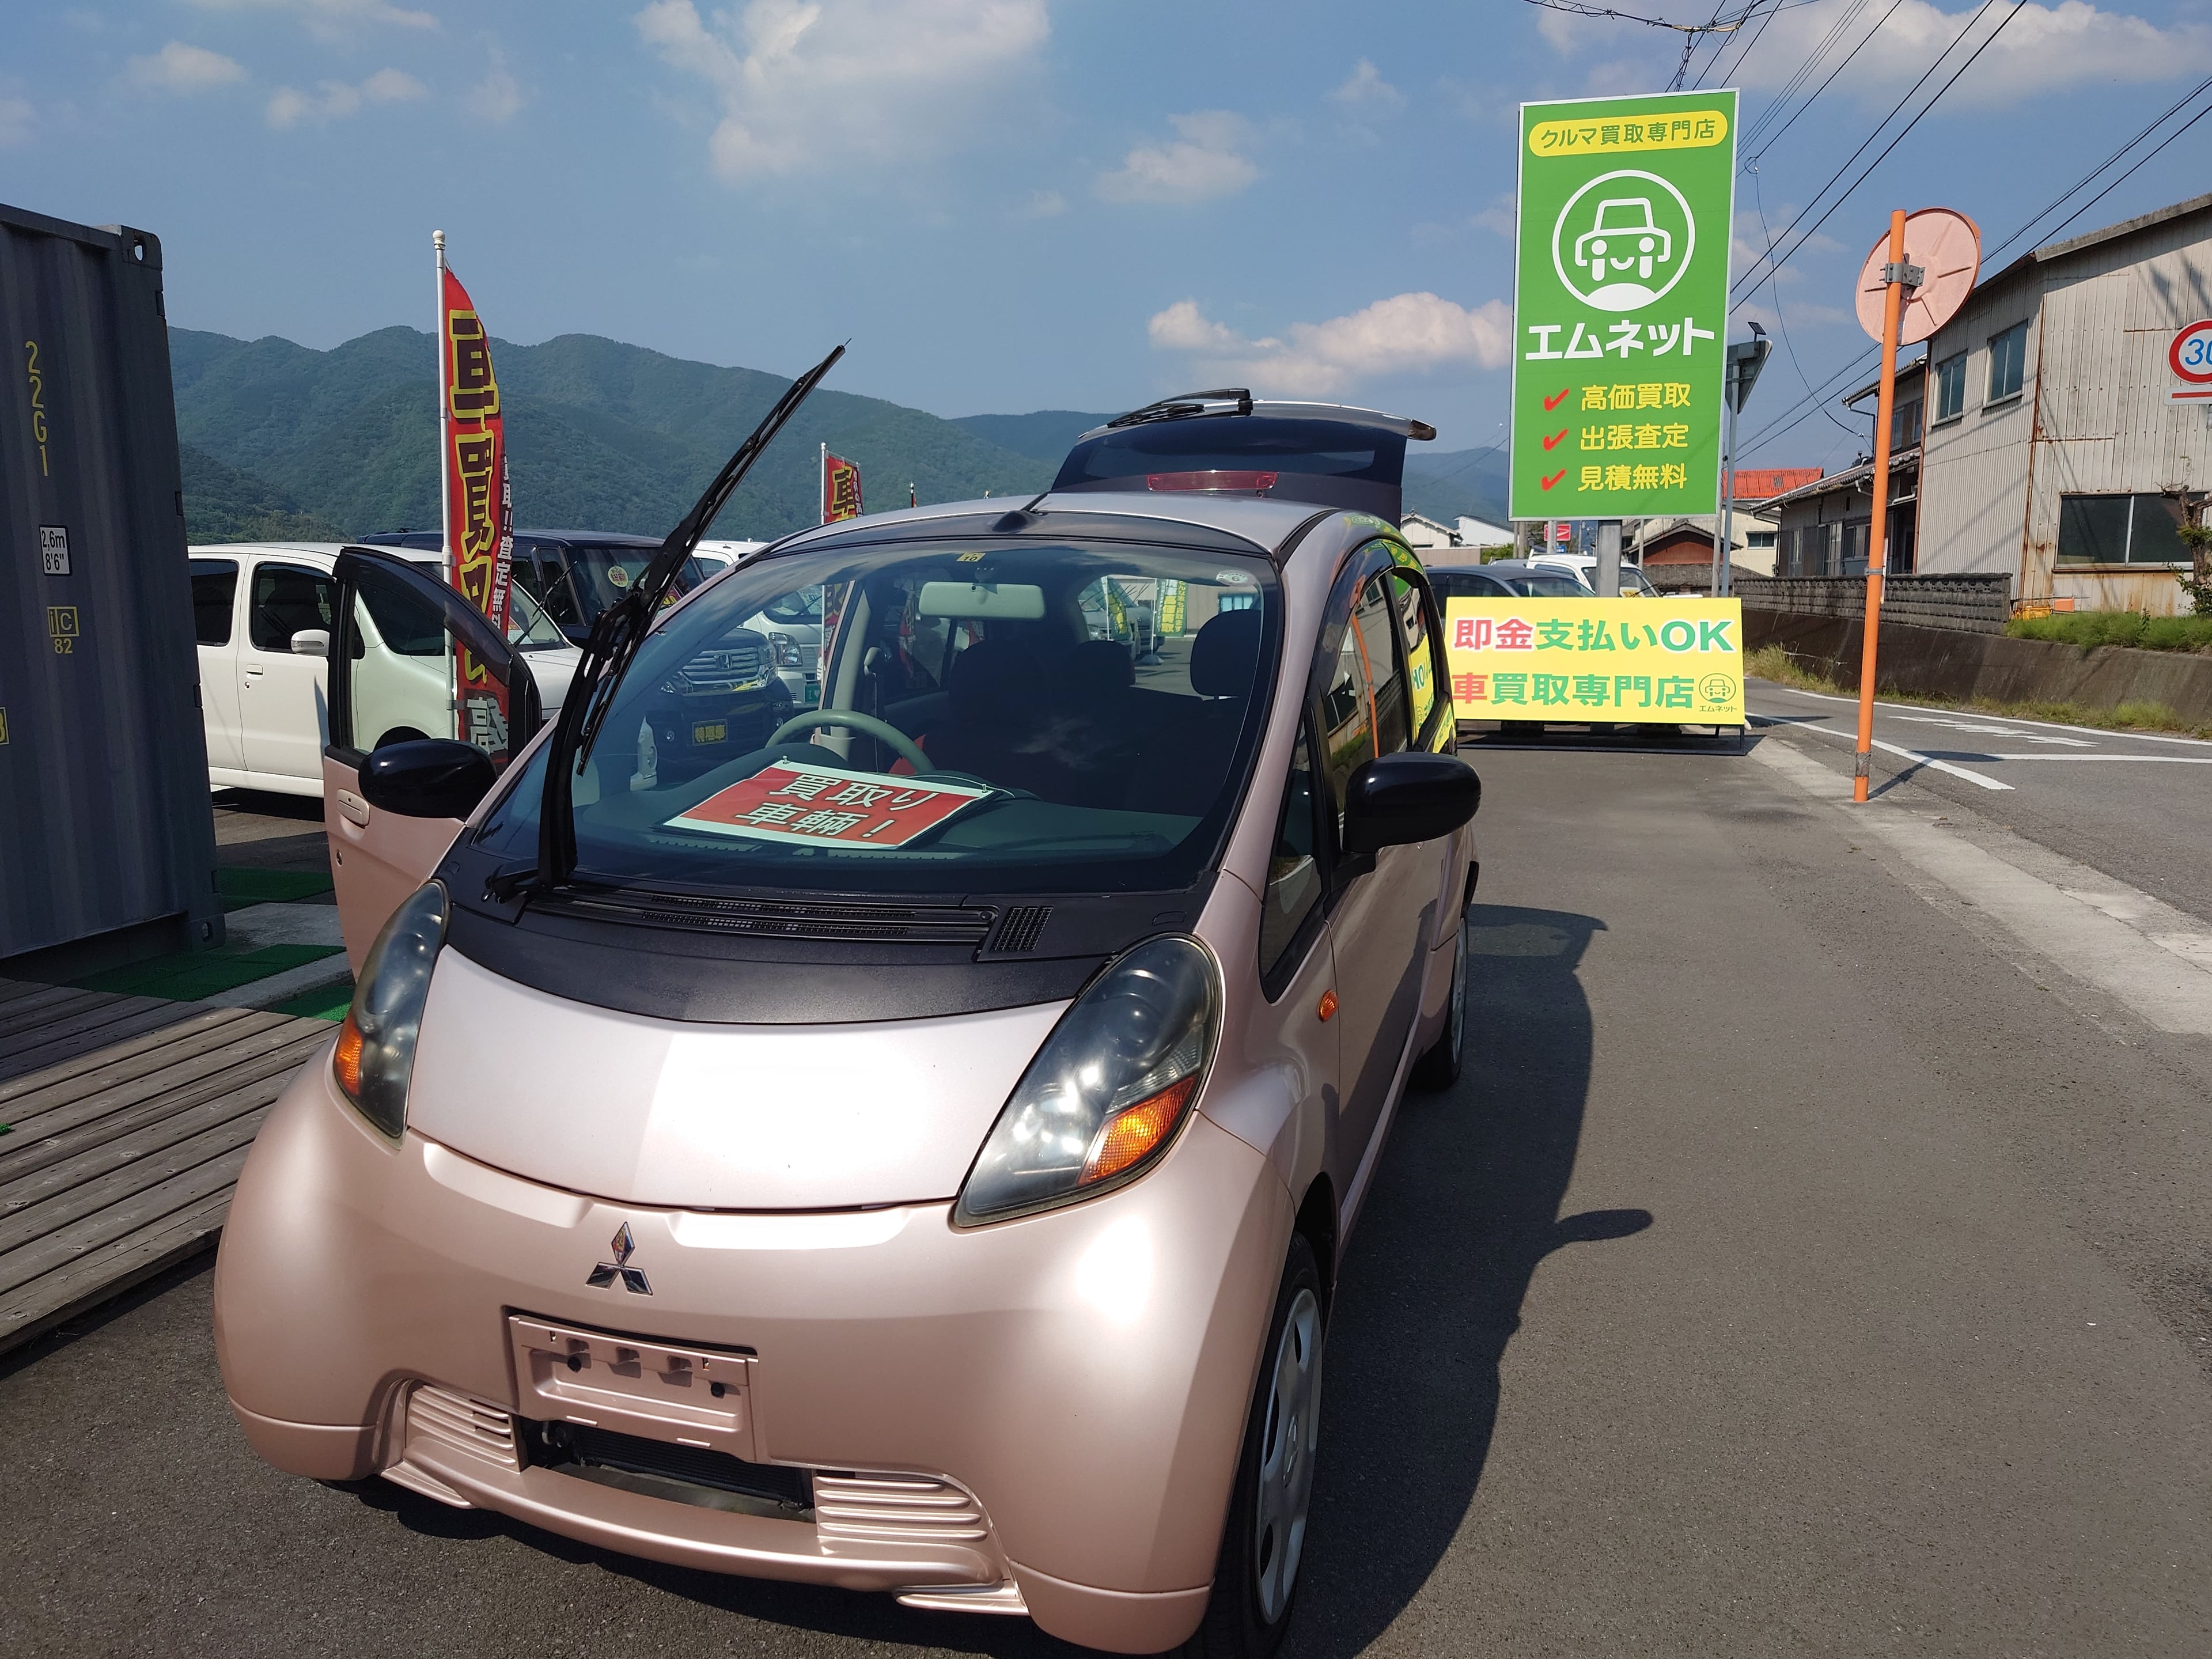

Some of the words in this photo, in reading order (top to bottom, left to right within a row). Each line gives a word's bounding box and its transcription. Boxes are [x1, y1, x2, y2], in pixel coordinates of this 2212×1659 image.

[1541, 119, 1715, 149] クルマ買取専門店
[1525, 317, 1715, 360] エムネット
[25, 341, 48, 476] 22G1
[1581, 382, 1691, 411] 高価買取
[1580, 422, 1688, 450] 出張査定
[1578, 463, 1687, 491] 見積無料
[41, 530, 65, 551] 2,6m
[55, 638, 73, 654] 82
[1453, 618, 1735, 652] 即金支払いOK
[1452, 672, 1695, 709] 車買取専門店
[770, 774, 940, 810] 買取り
